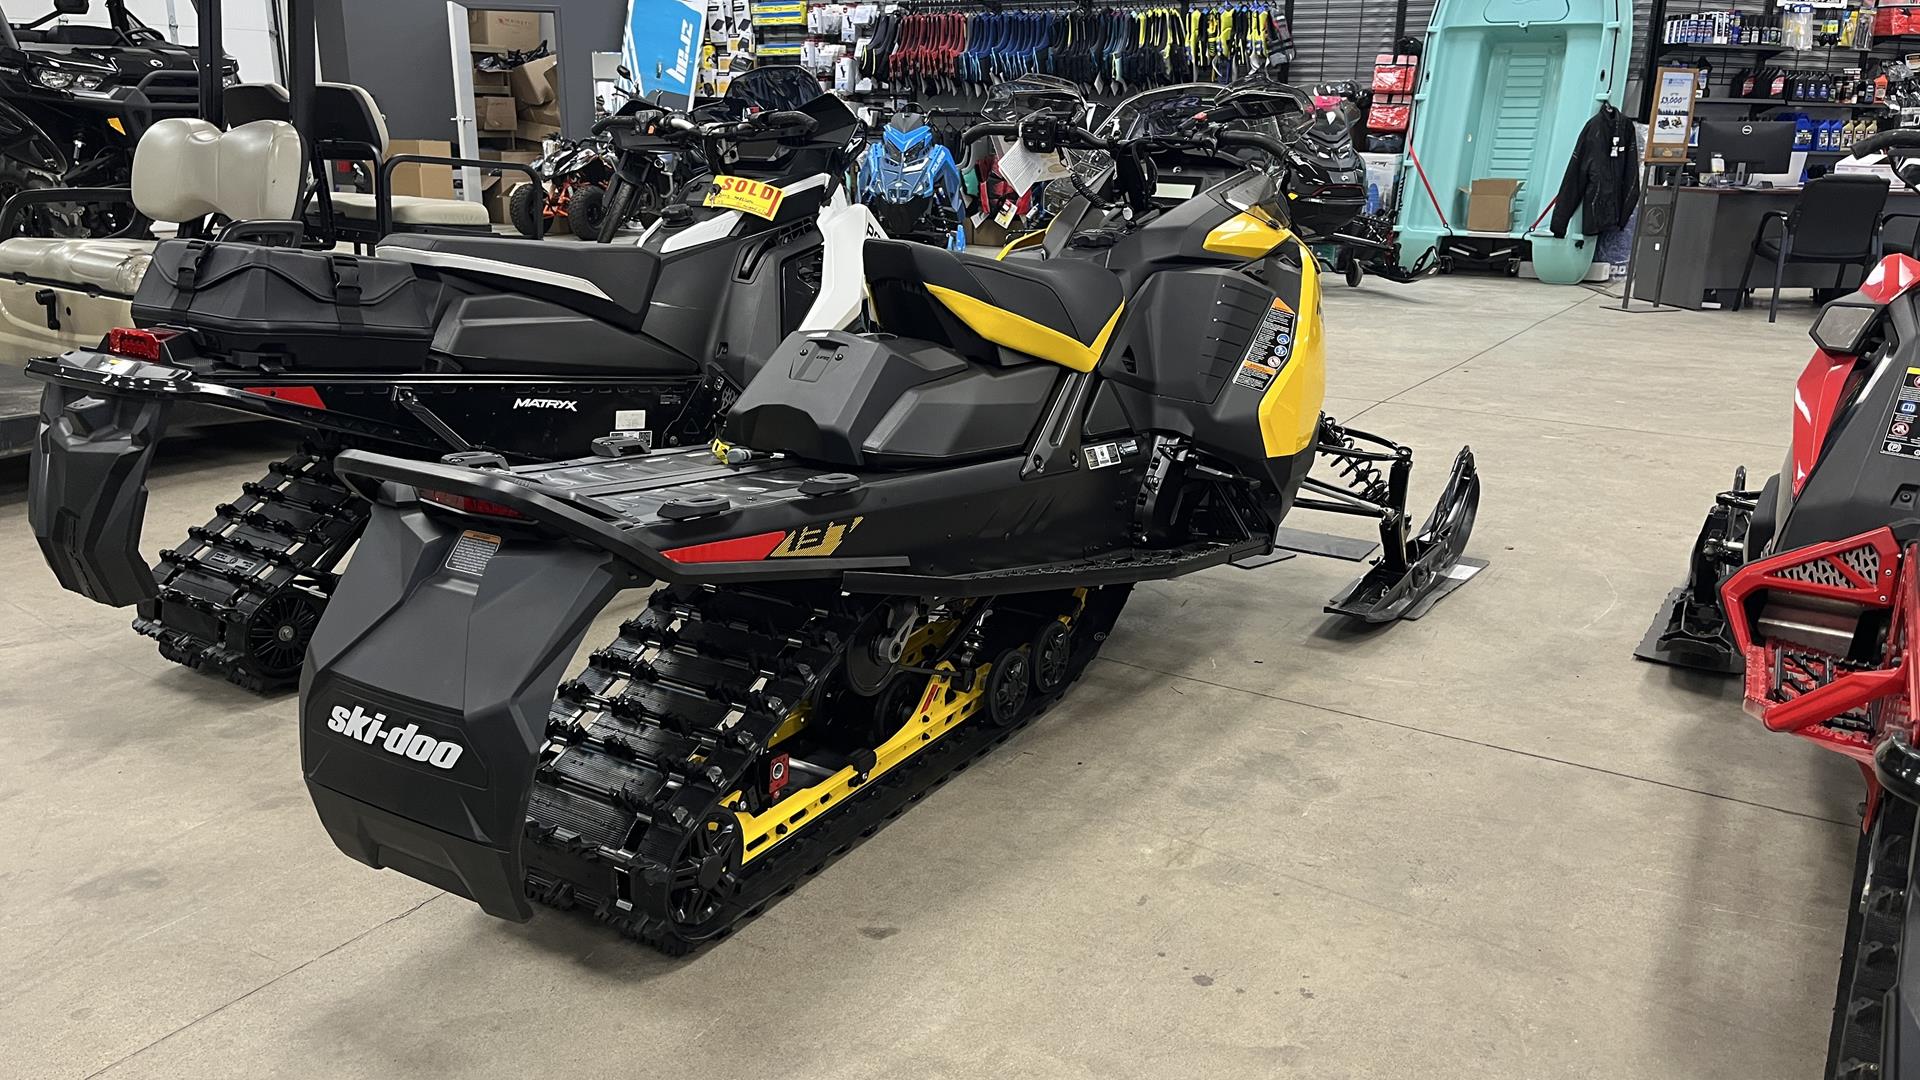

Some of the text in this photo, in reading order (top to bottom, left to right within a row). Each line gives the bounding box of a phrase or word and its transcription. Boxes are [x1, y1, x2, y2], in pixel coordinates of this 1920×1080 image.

[721, 177, 775, 200] SOLD
[512, 397, 578, 412] MATRYX
[327, 705, 464, 769] ski-doo
